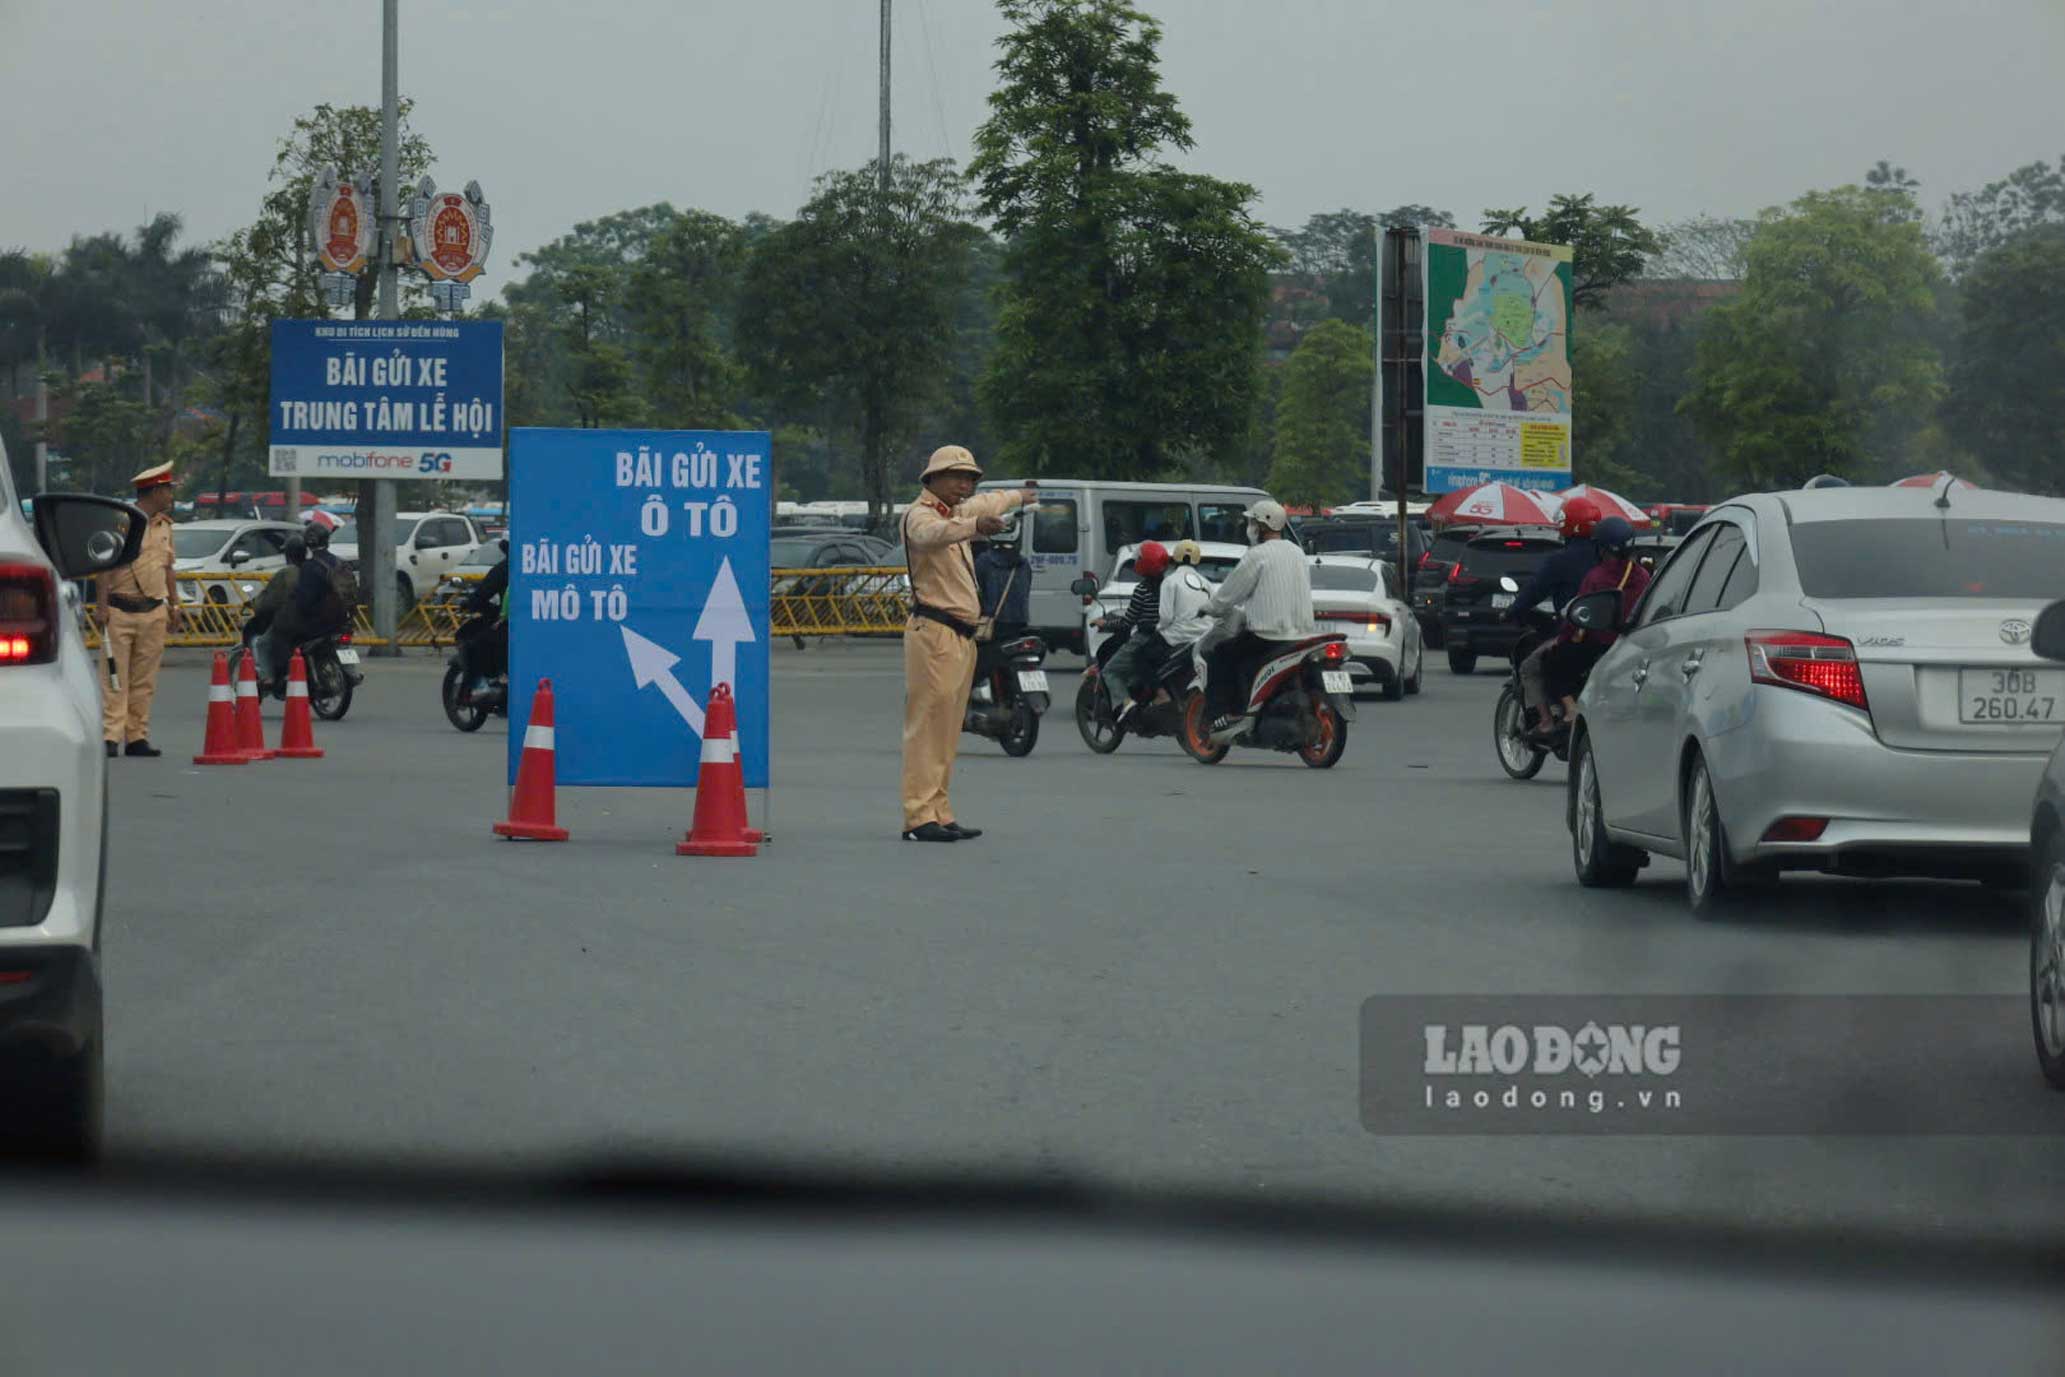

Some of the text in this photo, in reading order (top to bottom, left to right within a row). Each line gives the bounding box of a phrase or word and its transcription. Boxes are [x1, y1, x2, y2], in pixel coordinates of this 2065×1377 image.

[326, 348, 447, 387] BÃI GỬI XE
[280, 392, 493, 439] TRUNG TÂM LỄ HỘI
[317, 452, 452, 473] mobifone 5G
[616, 441, 761, 488] BÃI GỬI XE
[641, 494, 738, 538] Ô TÔ
[522, 534, 638, 575] BÃI GỬI XE
[531, 584, 628, 621] MÔ TÔ
[1992, 671, 2036, 694] 30B
[1974, 697, 2055, 719] 260.47
